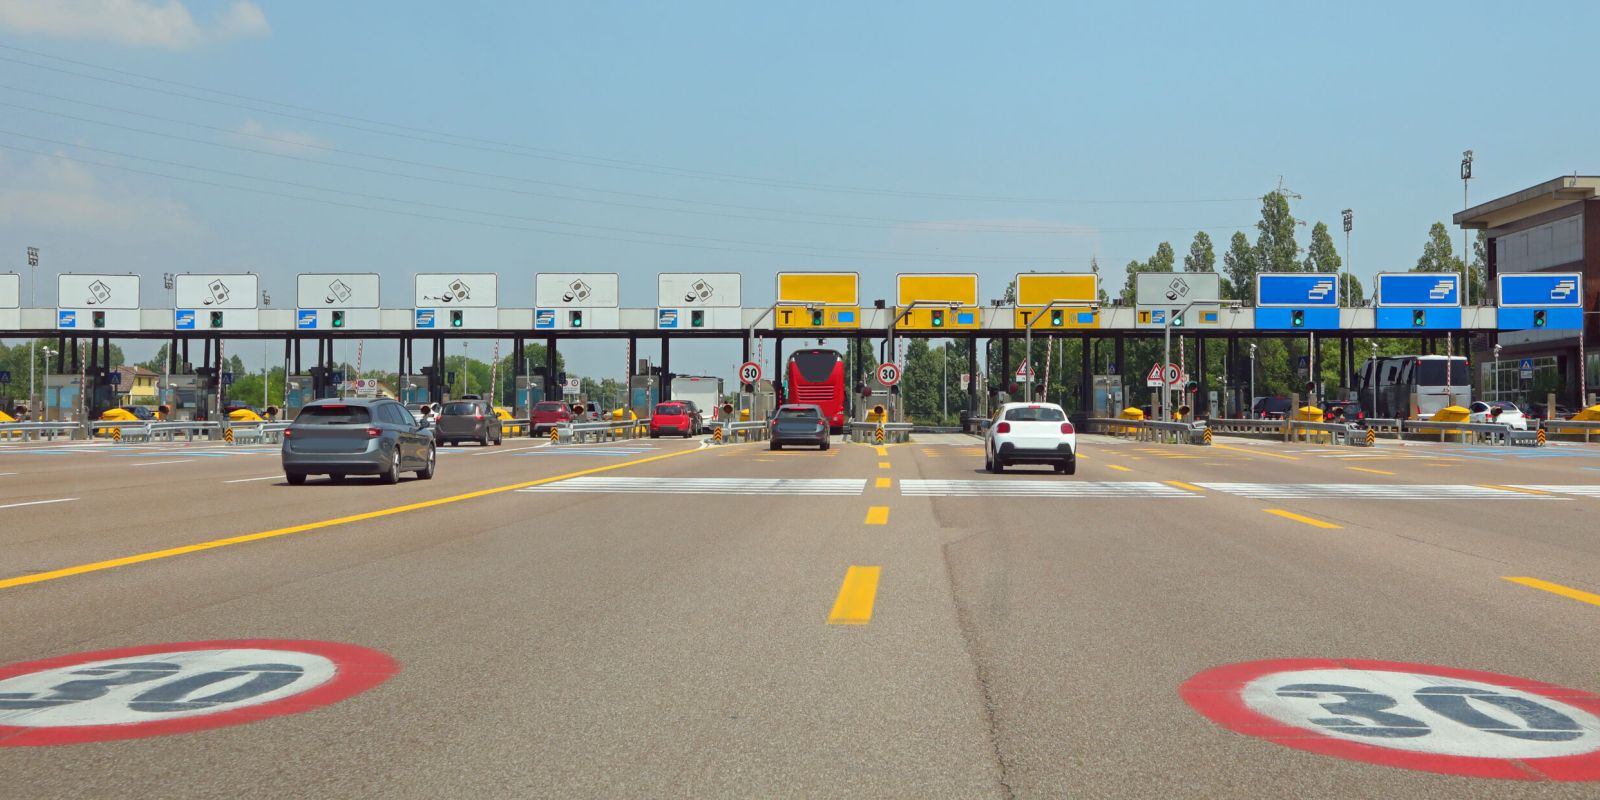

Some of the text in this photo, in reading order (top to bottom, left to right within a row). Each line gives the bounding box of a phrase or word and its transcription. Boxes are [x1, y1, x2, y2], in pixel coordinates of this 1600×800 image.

[781, 311, 792, 324] T
[902, 312, 912, 325] T
[1020, 312, 1032, 325] T
[1139, 312, 1149, 322] T
[744, 368, 757, 379] 30
[882, 369, 895, 380] 30
[0, 661, 304, 713] 30
[1275, 683, 1584, 741] 30
